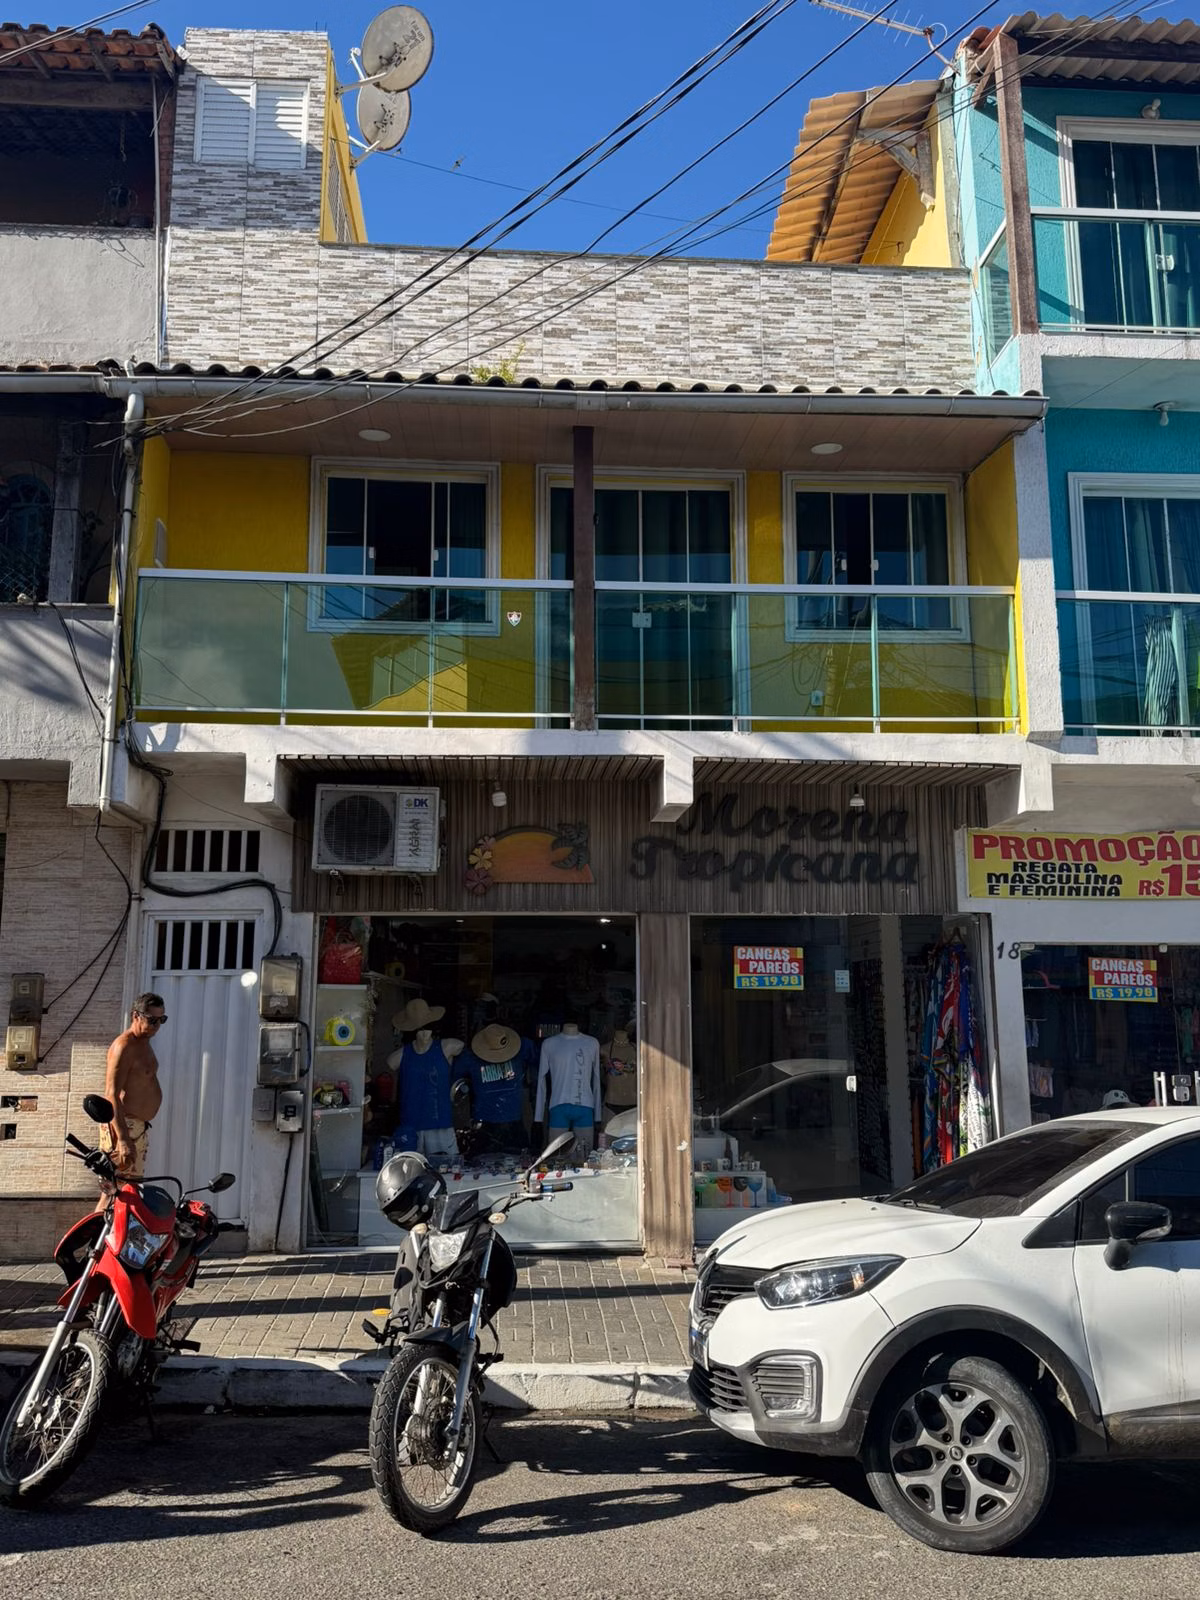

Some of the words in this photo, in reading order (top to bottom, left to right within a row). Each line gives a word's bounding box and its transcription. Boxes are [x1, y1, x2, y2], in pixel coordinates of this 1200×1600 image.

[414, 798, 428, 808] DK
[675, 791, 909, 843] Morena
[629, 835, 921, 893] Tropicana
[1012, 861, 1098, 873] REGATA
[986, 872, 1123, 885] MASCULINA
[988, 884, 1000, 896] E
[1009, 885, 1121, 897] FEMININA
[737, 947, 790, 960] CANGAS
[997, 941, 1020, 960] 18
[1091, 959, 1144, 972] CANGAS
[741, 976, 759, 987] R$
[1096, 988, 1114, 998] R$
